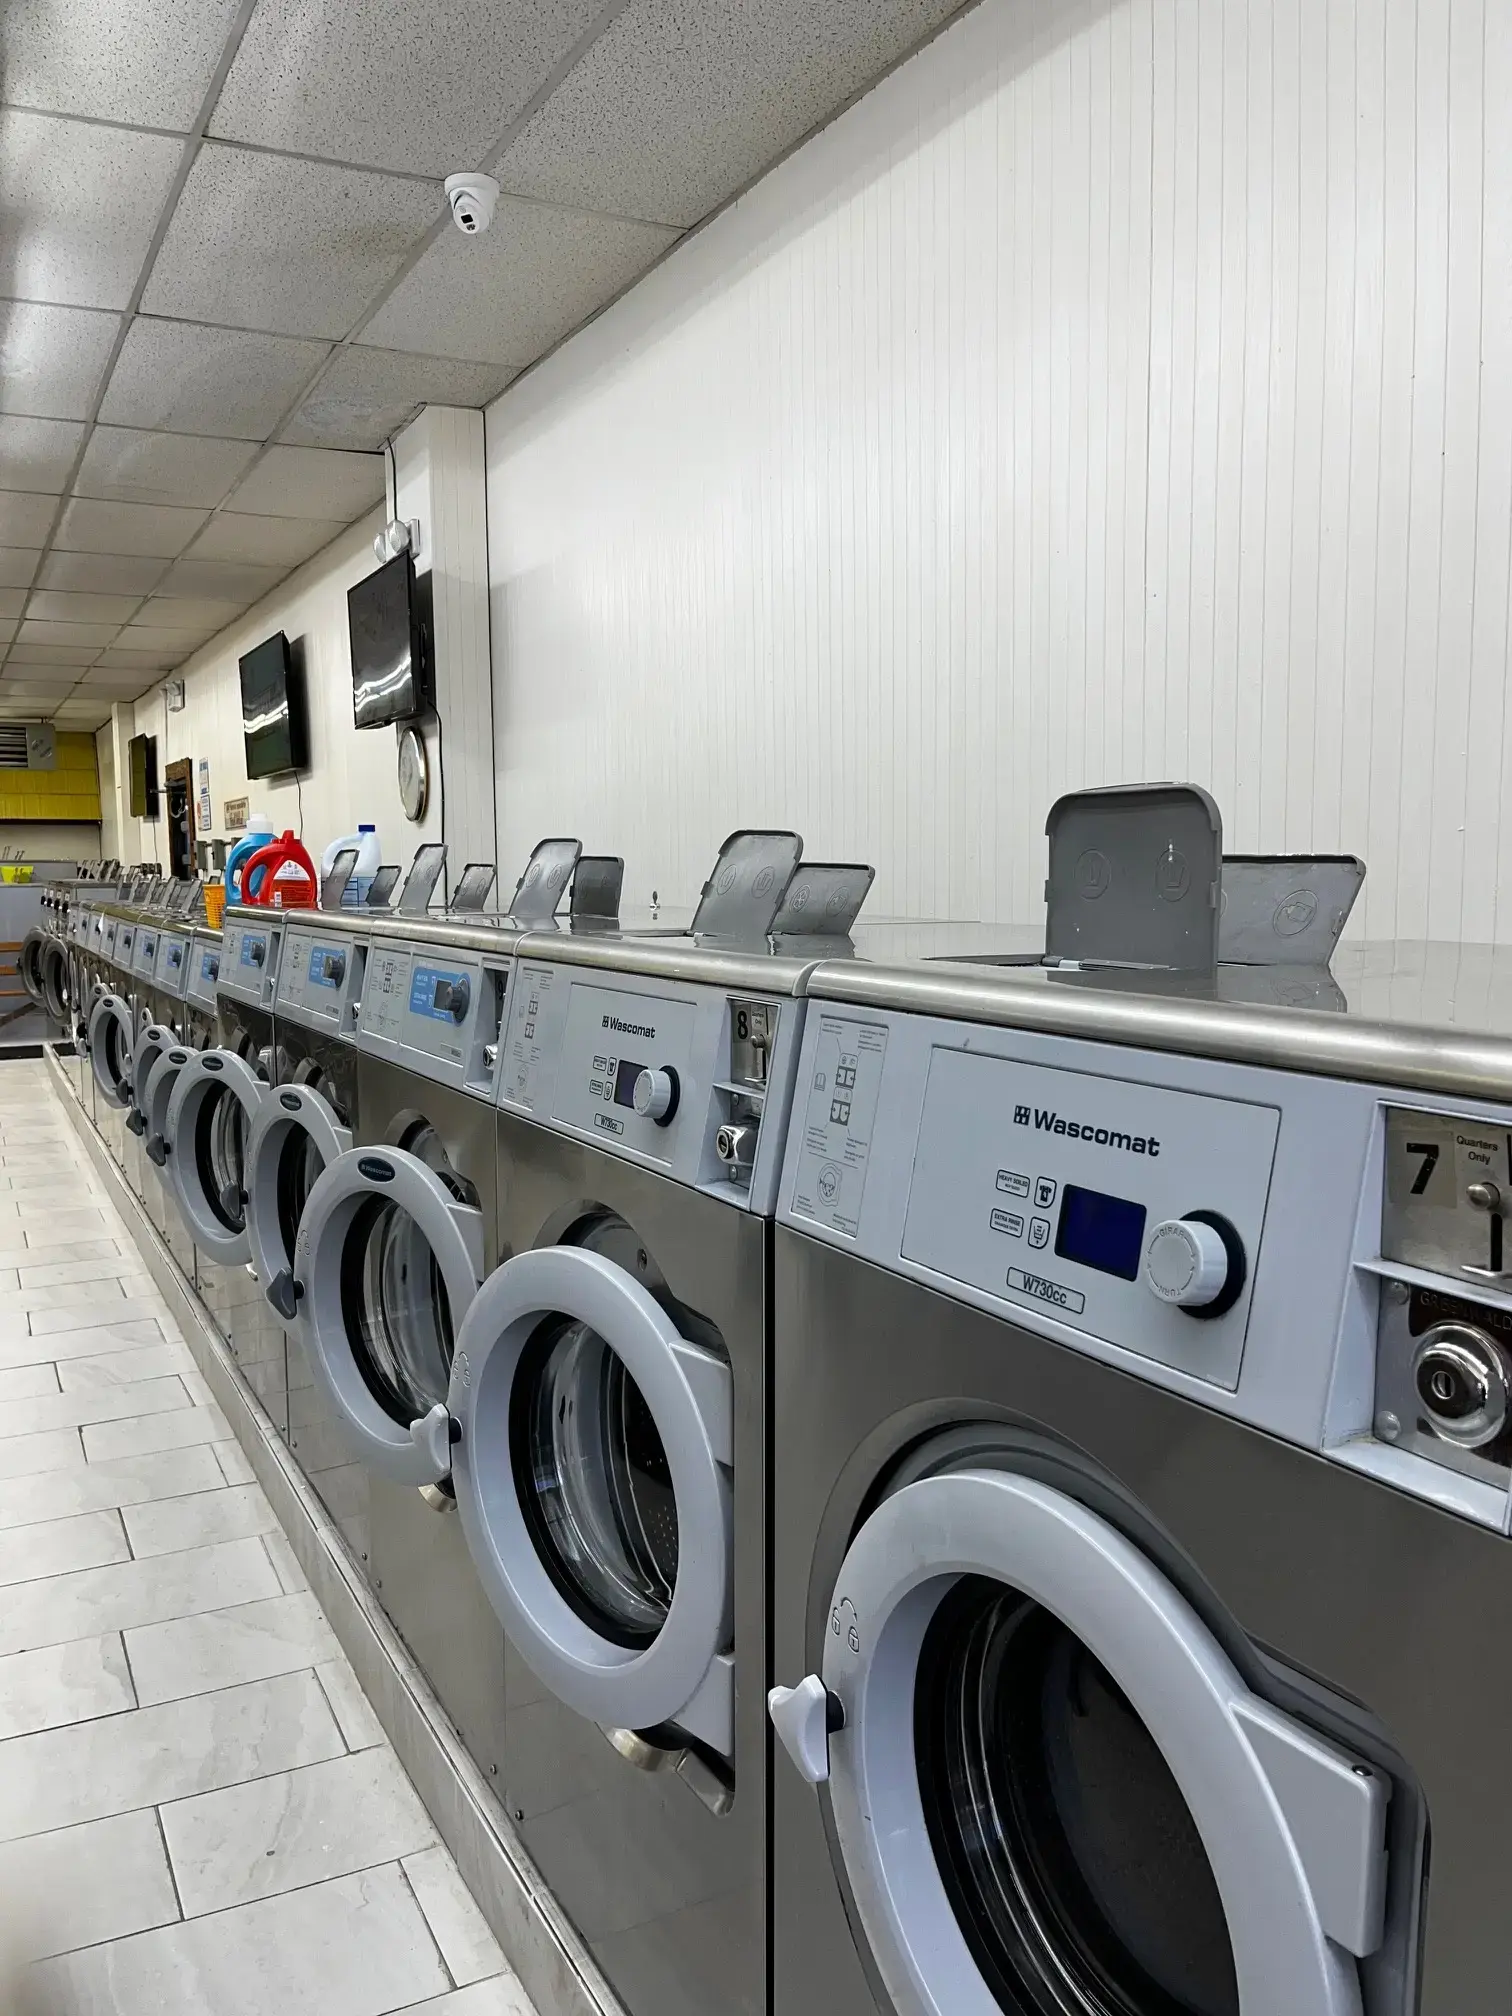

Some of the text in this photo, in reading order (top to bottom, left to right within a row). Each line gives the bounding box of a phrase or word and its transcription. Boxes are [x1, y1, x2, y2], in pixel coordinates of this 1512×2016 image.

[610, 1016, 656, 1039] Wascomat
[737, 1010, 748, 1039] 8
[1034, 1108, 1160, 1157] Wascomat
[1456, 1135, 1499, 1152] Quarters
[1467, 1151, 1491, 1166] Only
[1406, 1142, 1439, 1195] 7
[999, 1174, 1013, 1183] HEAVY
[994, 1213, 1007, 1223] EXTRA
[1159, 1226, 1184, 1238] GIRAR
[1023, 1274, 1067, 1305] W730cc
[1159, 1285, 1182, 1297] TURN
